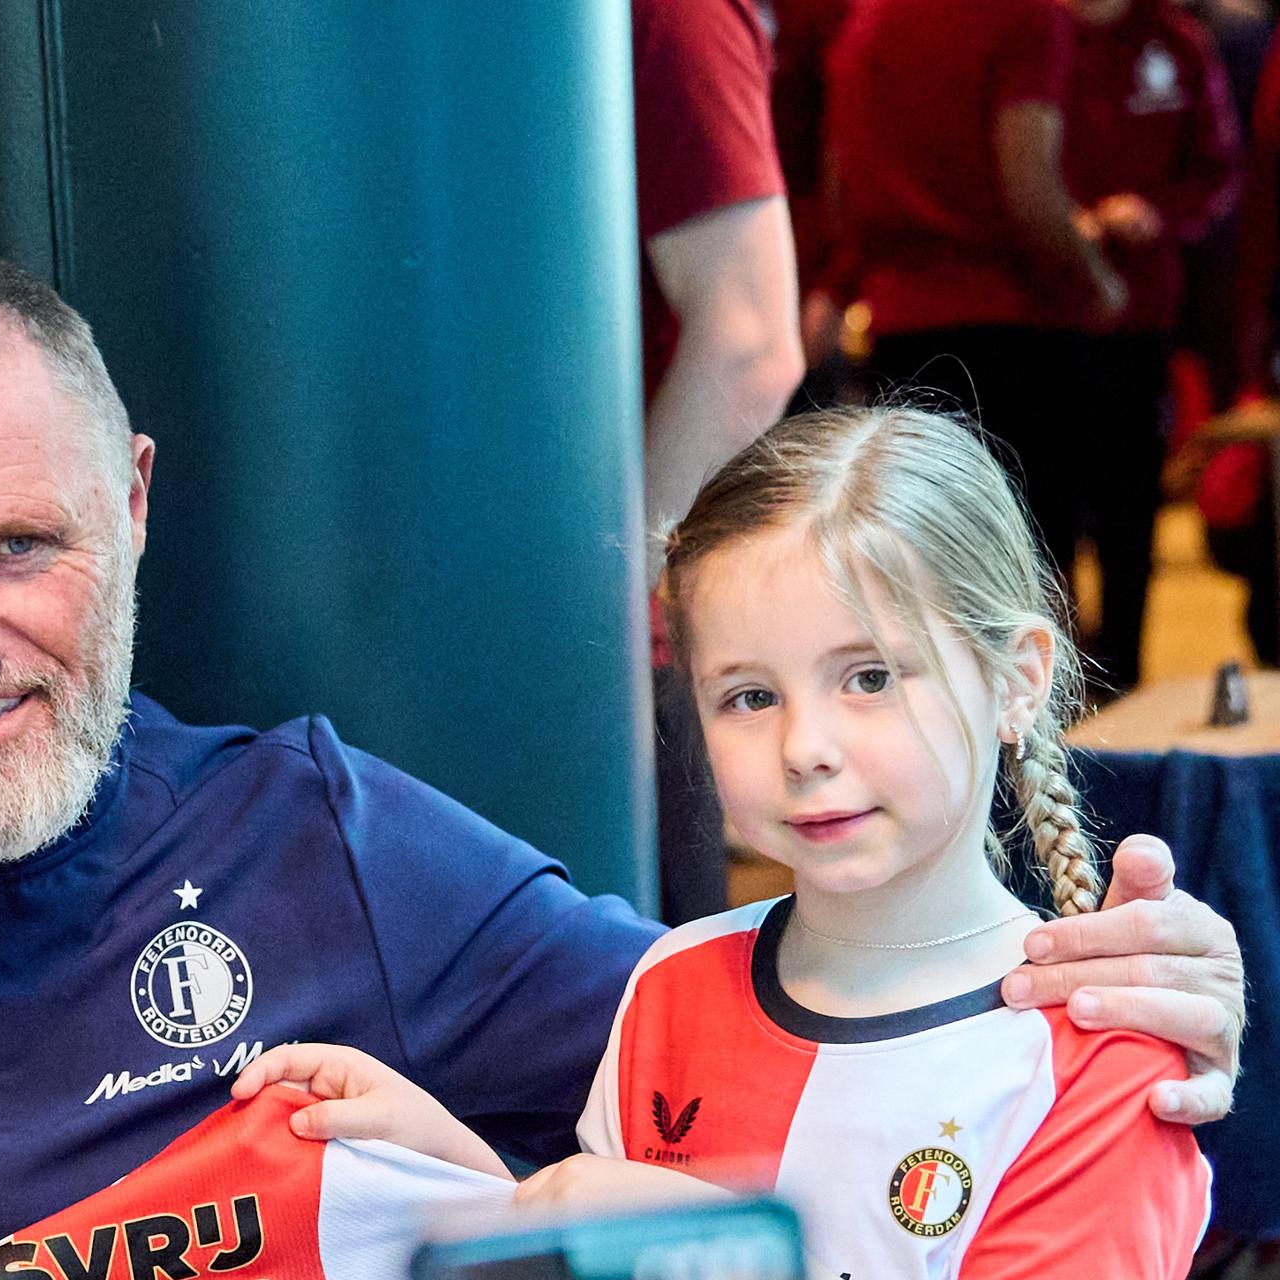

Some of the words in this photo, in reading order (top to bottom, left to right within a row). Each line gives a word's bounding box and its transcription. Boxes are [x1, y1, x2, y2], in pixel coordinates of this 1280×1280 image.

[140, 927, 236, 973] FEYENOORD
[142, 994, 246, 1042] ROTTERDAM
[900, 1149, 972, 1189] FEYENOORD
[890, 1195, 962, 1236] ROTTERDAM
